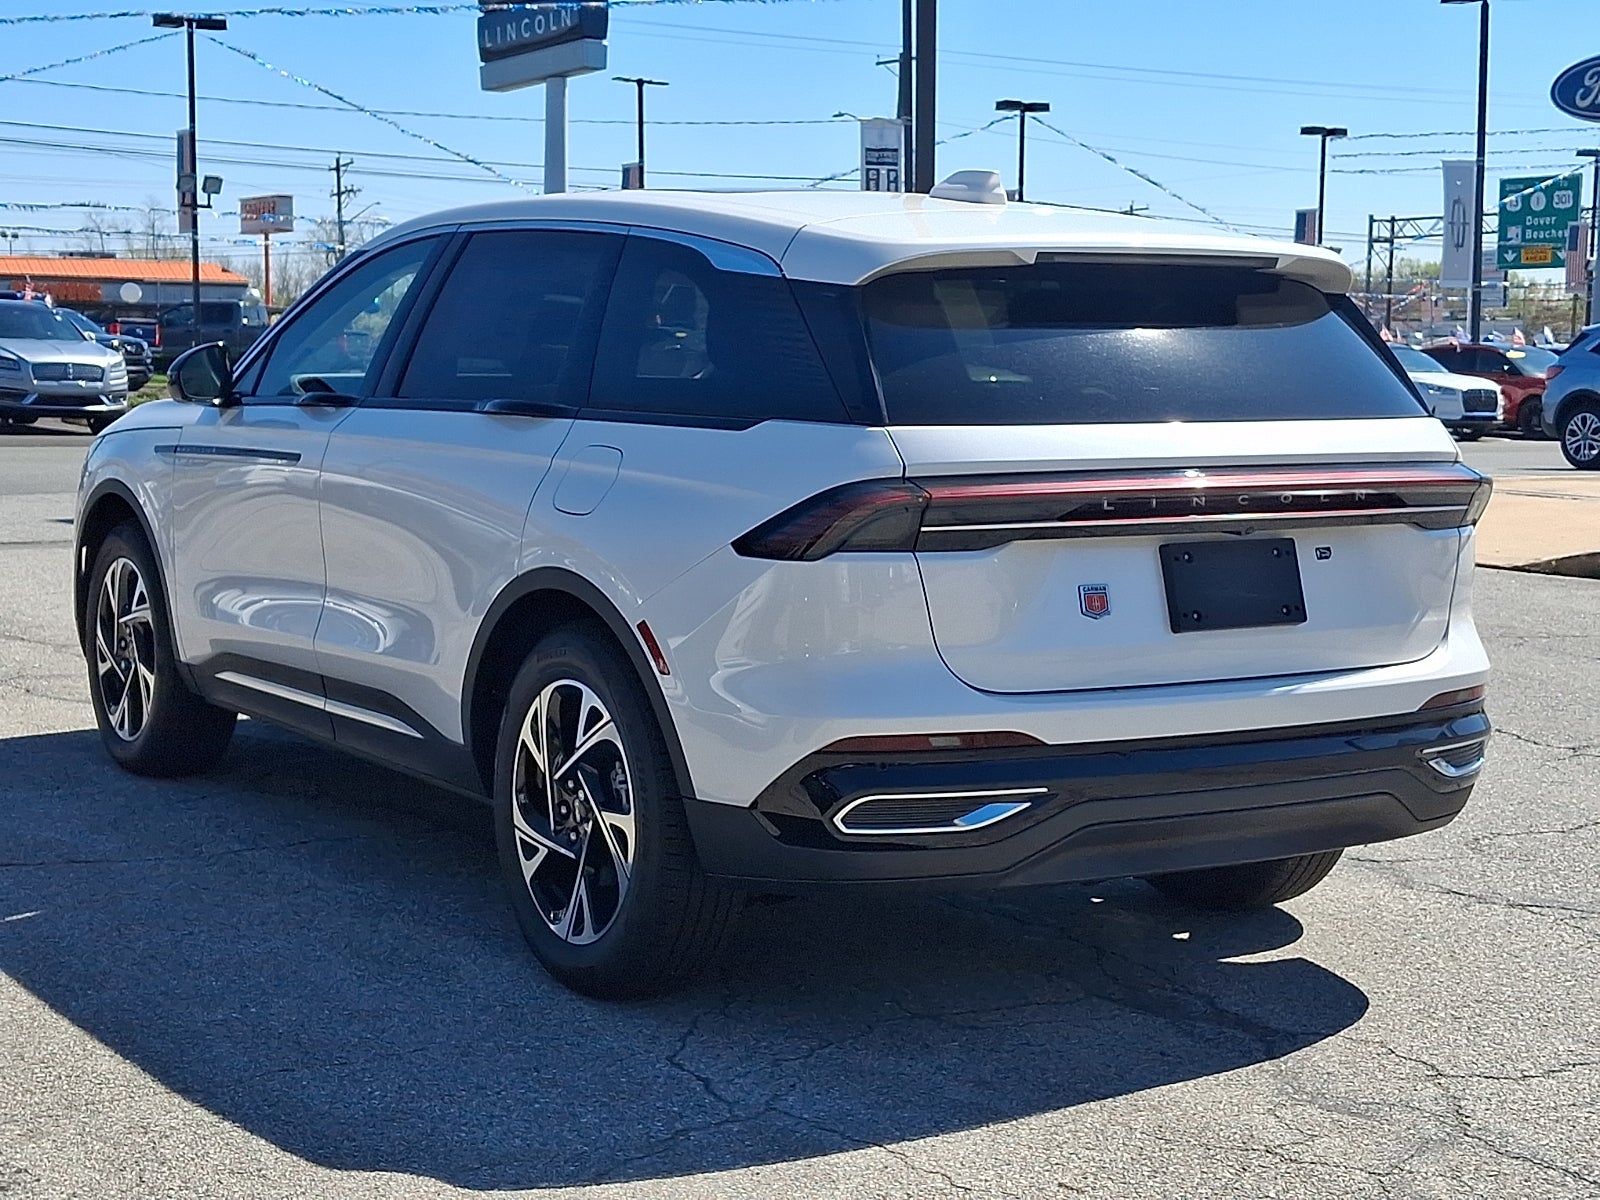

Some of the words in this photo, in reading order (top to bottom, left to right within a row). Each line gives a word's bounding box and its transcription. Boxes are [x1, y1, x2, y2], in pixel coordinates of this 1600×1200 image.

[484, 9, 572, 48] LINCOLN
[1554, 193, 1571, 205] 301
[1525, 215, 1557, 226] Dover
[1103, 489, 1366, 510] LINCOLN
